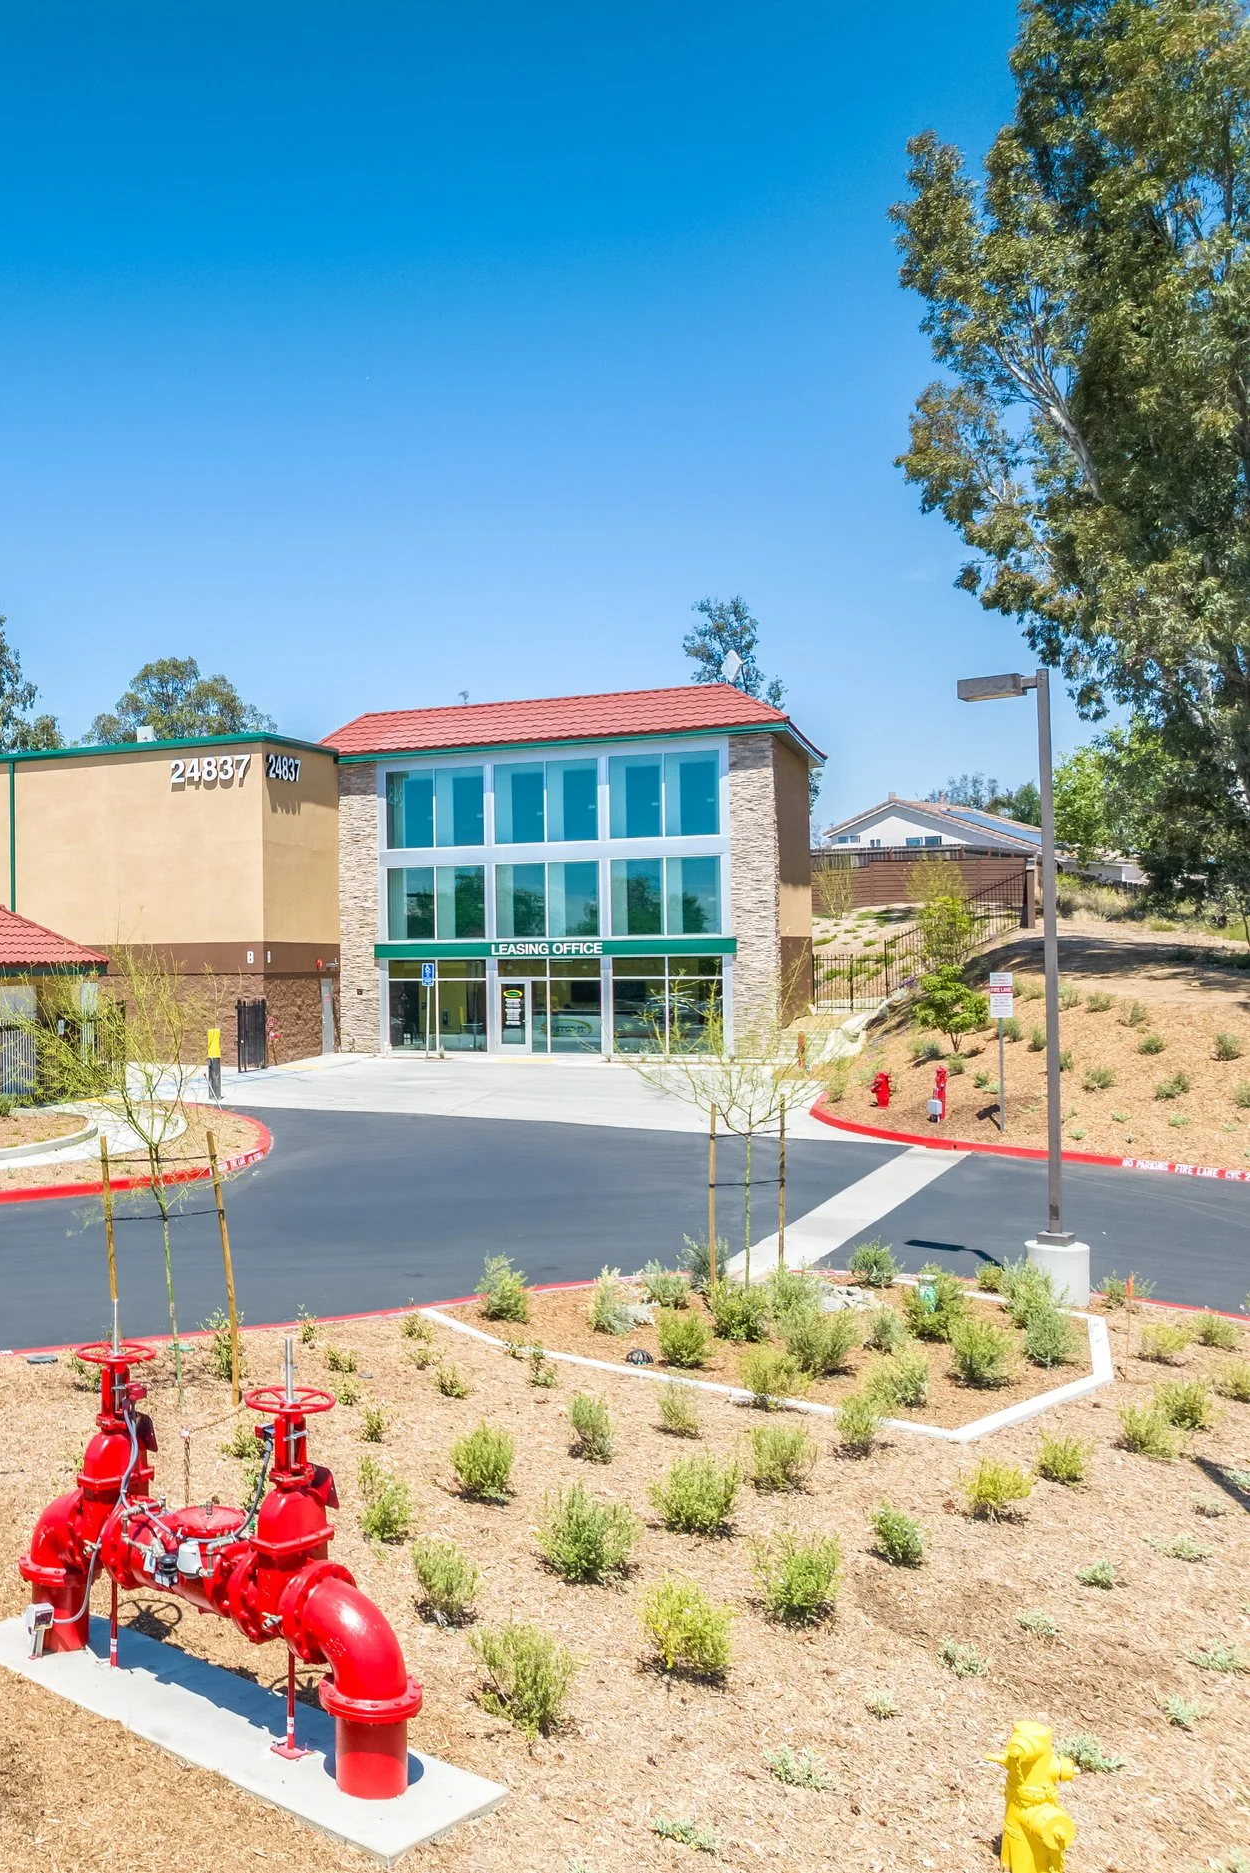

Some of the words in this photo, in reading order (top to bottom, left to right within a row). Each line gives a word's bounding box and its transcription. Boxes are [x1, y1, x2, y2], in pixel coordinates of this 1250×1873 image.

[171, 755, 250, 782] 24837
[268, 754, 301, 782] 24837
[491, 944, 549, 955] LEASING
[552, 943, 603, 954] OFFICE
[1122, 1158, 1134, 1167] NO
[1136, 1159, 1169, 1171] PARKING
[1175, 1163, 1194, 1174] FIRE
[1197, 1167, 1219, 1178] LANE
[1225, 1170, 1242, 1179] CVC
